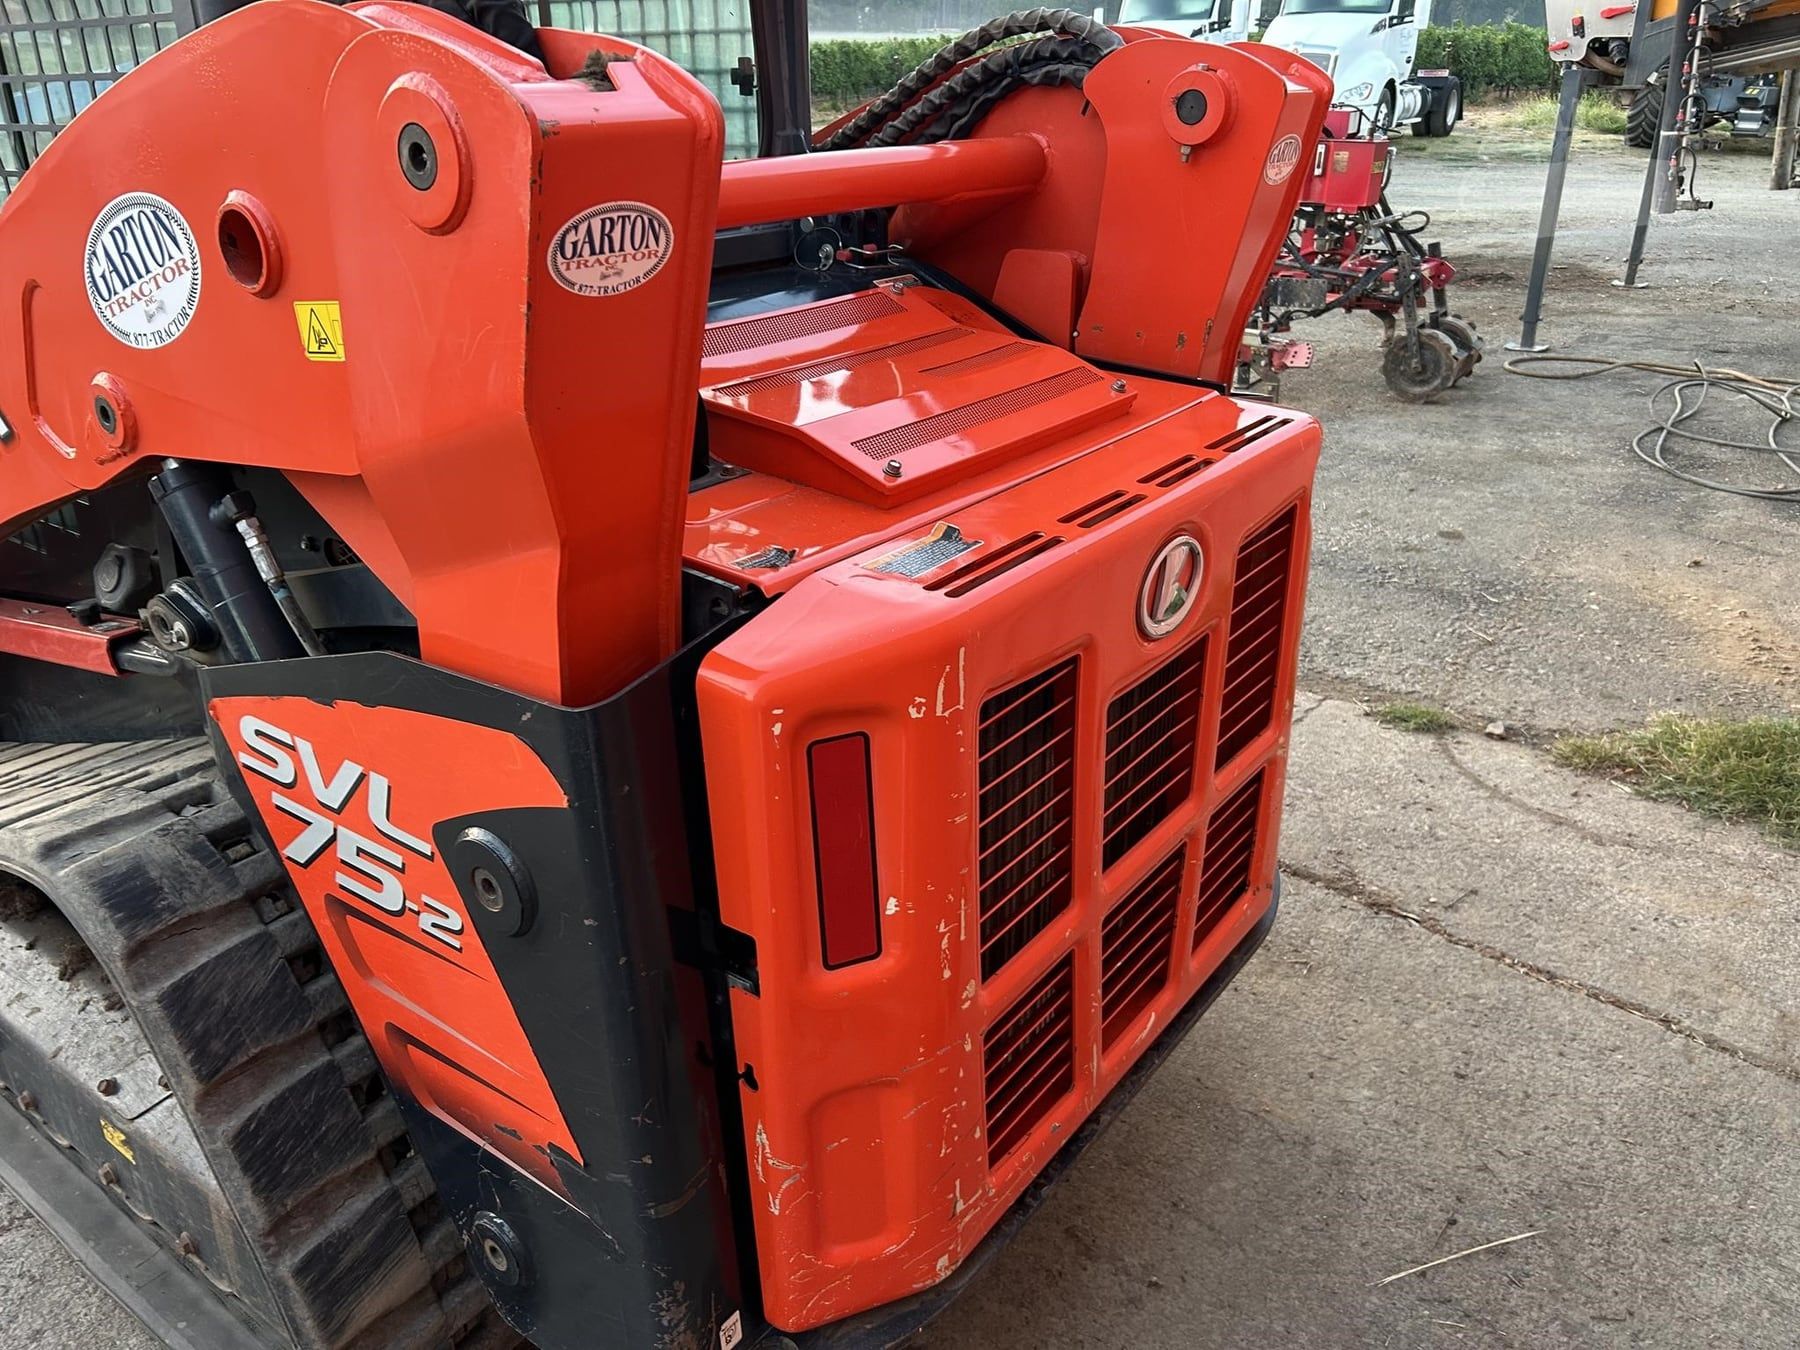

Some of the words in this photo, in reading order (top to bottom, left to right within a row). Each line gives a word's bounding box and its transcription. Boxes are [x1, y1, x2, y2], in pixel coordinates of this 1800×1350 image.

[87, 209, 184, 303] GARTON
[558, 214, 661, 261] GARTON
[561, 249, 660, 272] TRACTOR
[104, 257, 191, 319] TRACTOR
[577, 275, 642, 296] 877-TRACTOR
[133, 306, 191, 347] 877-TRACTOR
[238, 715, 434, 862] SVL
[271, 790, 464, 953] 75-2
